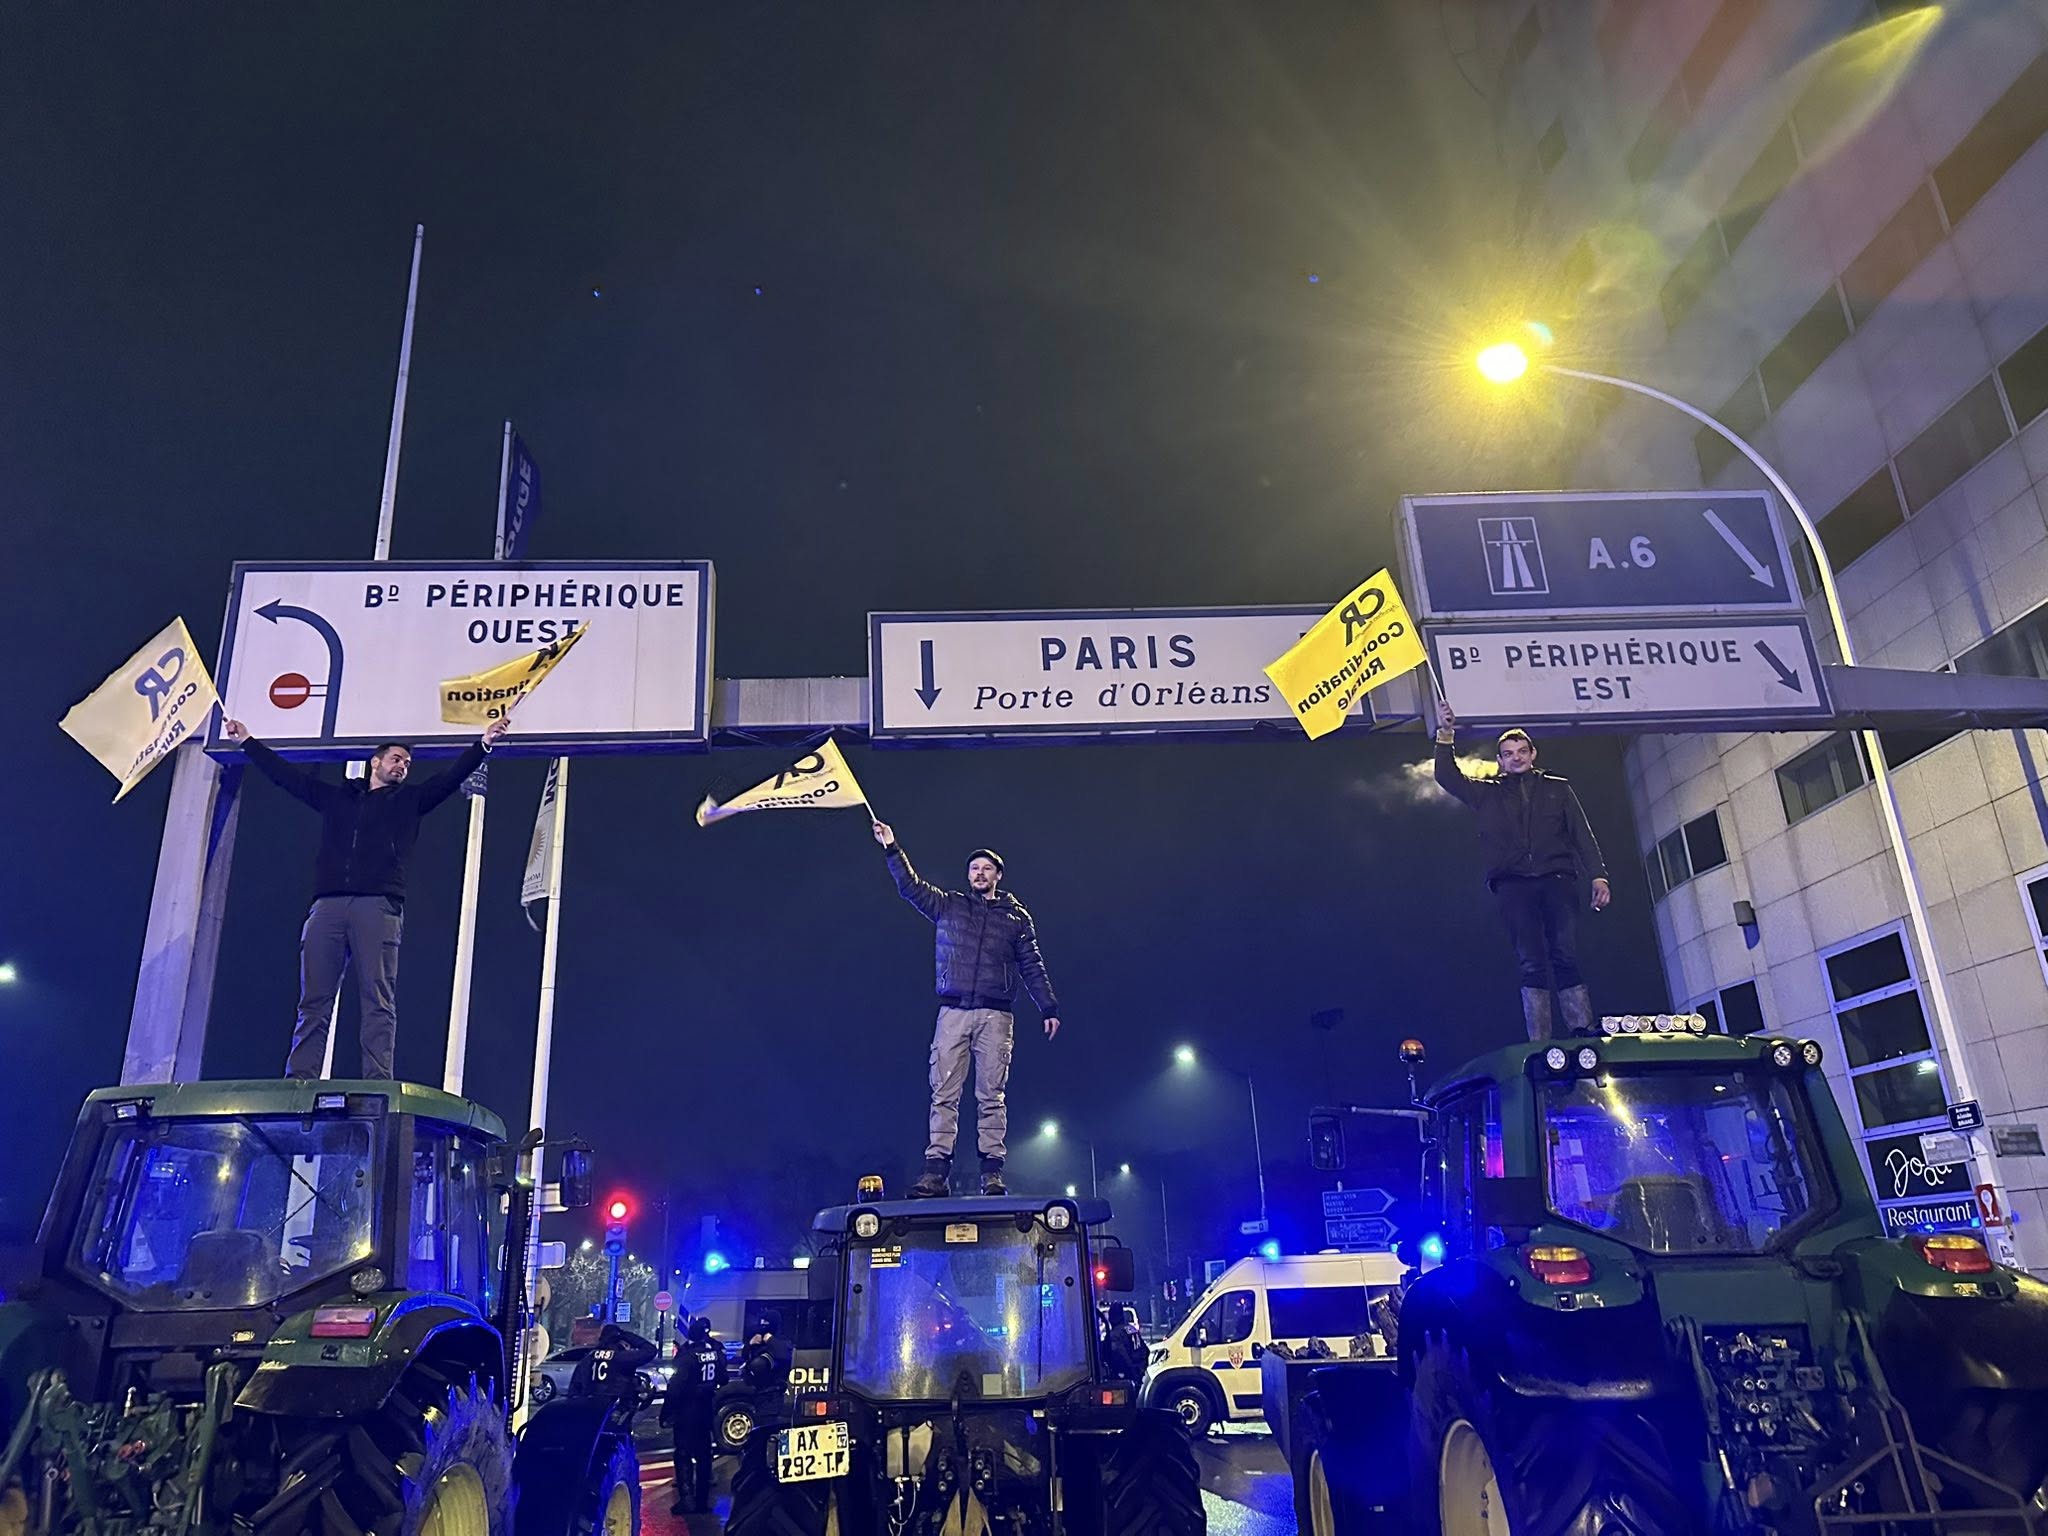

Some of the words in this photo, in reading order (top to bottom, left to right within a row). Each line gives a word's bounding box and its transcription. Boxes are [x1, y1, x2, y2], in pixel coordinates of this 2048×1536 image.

[1588, 535, 1656, 570] A.6
[426, 580, 684, 608] PÉRIPHÉRIQUE
[468, 619, 579, 644] OUEST
[1040, 635, 1196, 671] PARIS
[1505, 638, 1742, 669] PÉRIPHÉRIQUE
[973, 685, 1074, 711] Porte
[1098, 681, 1271, 708] d'Orléans
[1572, 676, 1633, 701] EST
[1887, 1202, 1972, 1227] Restaurant
[700, 1352, 716, 1362] CRS
[591, 1362, 608, 1381] 1C
[701, 1363, 716, 1382] 1B
[797, 1429, 819, 1453] AX
